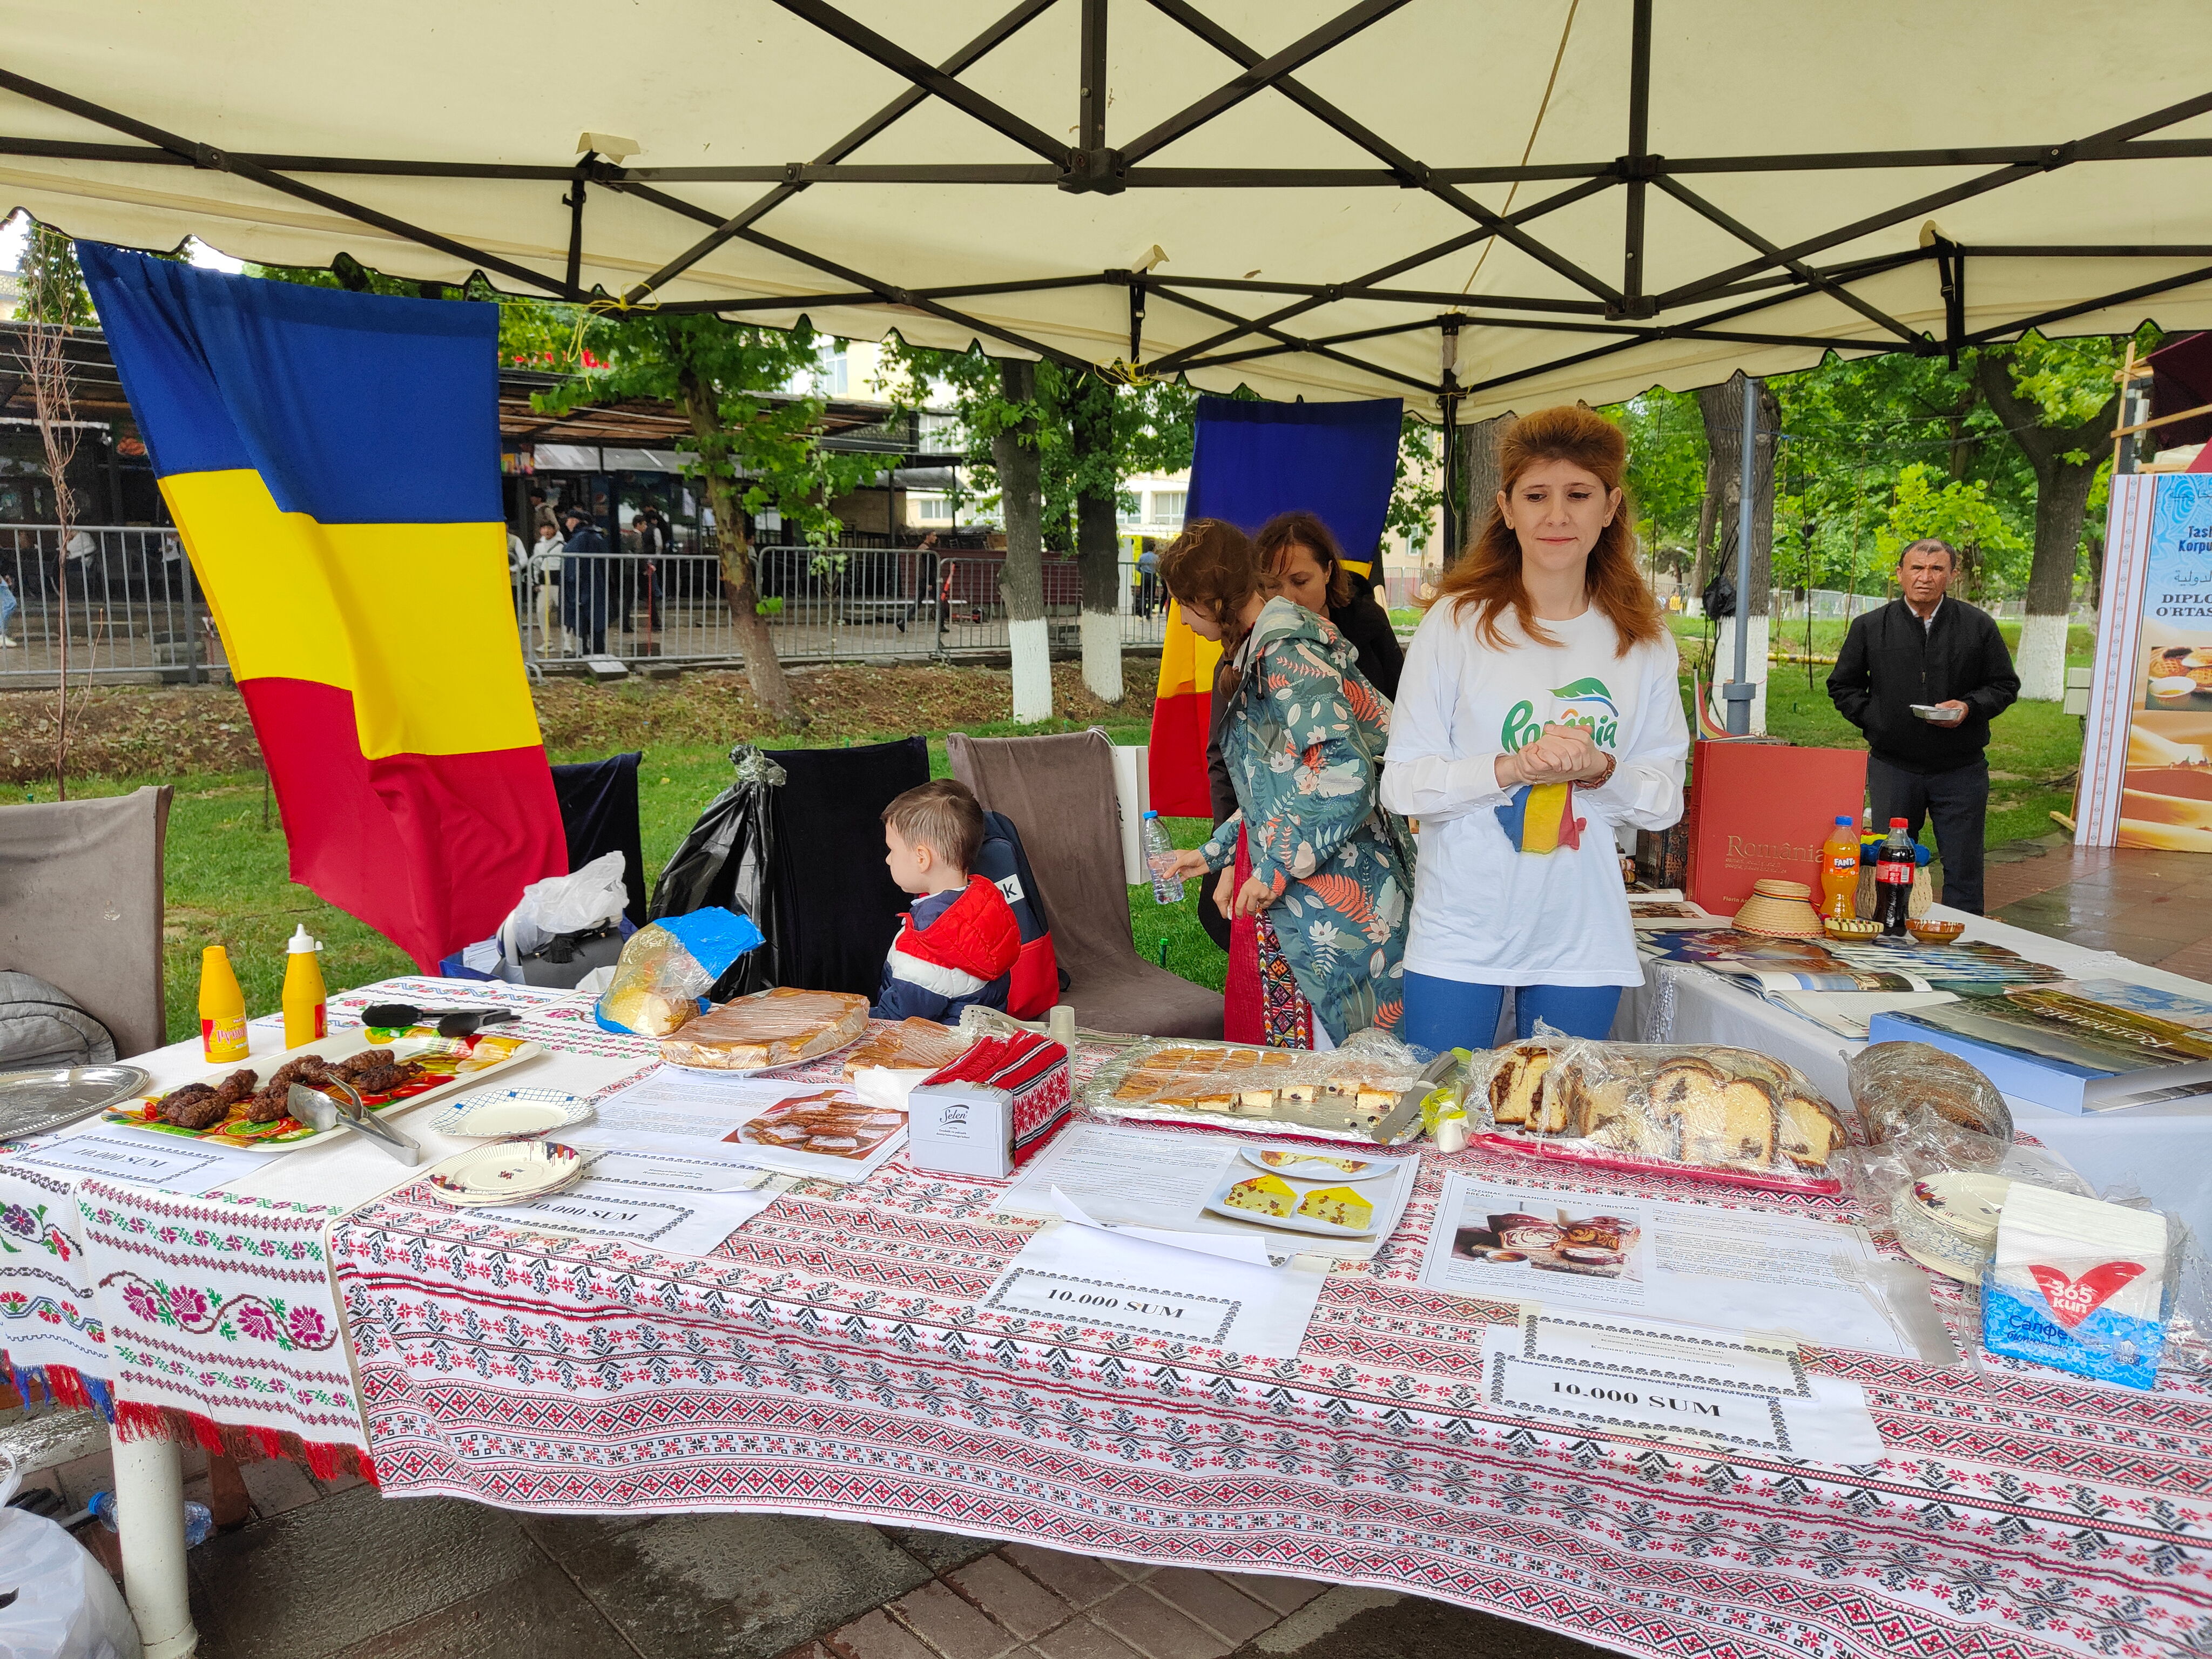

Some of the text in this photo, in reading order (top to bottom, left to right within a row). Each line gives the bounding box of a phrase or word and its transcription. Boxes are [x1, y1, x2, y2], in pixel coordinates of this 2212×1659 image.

[1833, 858, 1856, 867] FANTA
[2033, 1007, 2177, 1048] Romania
[940, 1109, 967, 1123] Selen
[72, 1149, 170, 1168] 10.000 SUM
[1467, 1188, 1503, 1196] COZONAC
[1506, 1193, 1550, 1202] (ROMANIAN
[526, 1202, 640, 1221] 10.000 SUM
[2050, 1280, 2093, 1303] 365
[1046, 1289, 1186, 1319] 10.000 SUM
[2009, 1315, 2074, 1342] Салфе
[1550, 1381, 1724, 1418] 10.000 SUM
